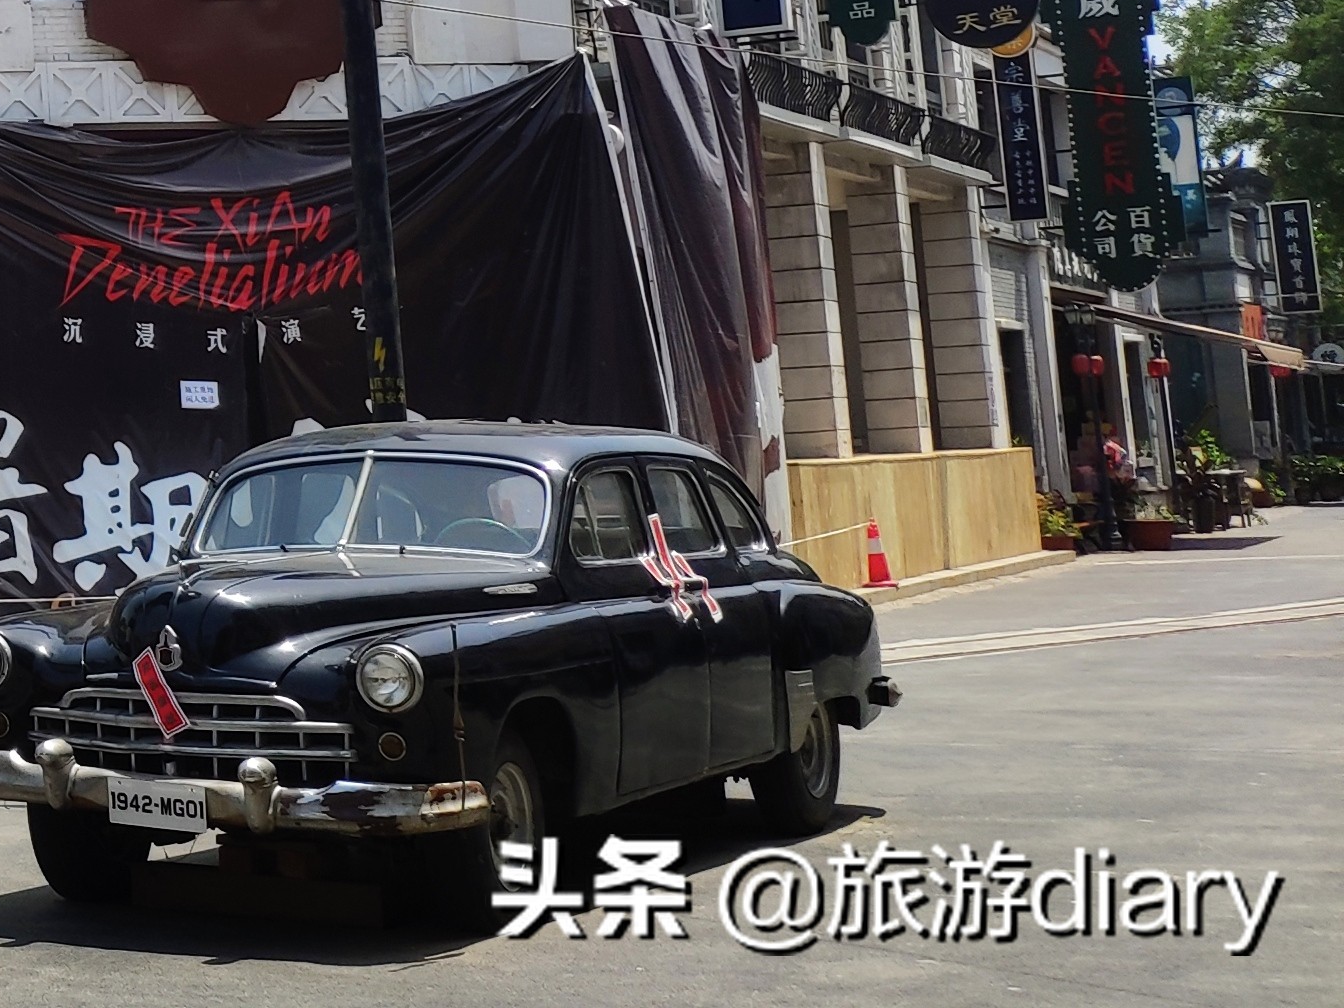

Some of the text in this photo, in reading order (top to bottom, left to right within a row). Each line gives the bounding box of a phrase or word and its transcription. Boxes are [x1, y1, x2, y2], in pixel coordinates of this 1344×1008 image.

[953, 5, 1022, 34] 天堂
[1092, 209, 1118, 260] 公司
[1126, 206, 1155, 258] 百貨
[111, 791, 204, 820] 1942-MG01
